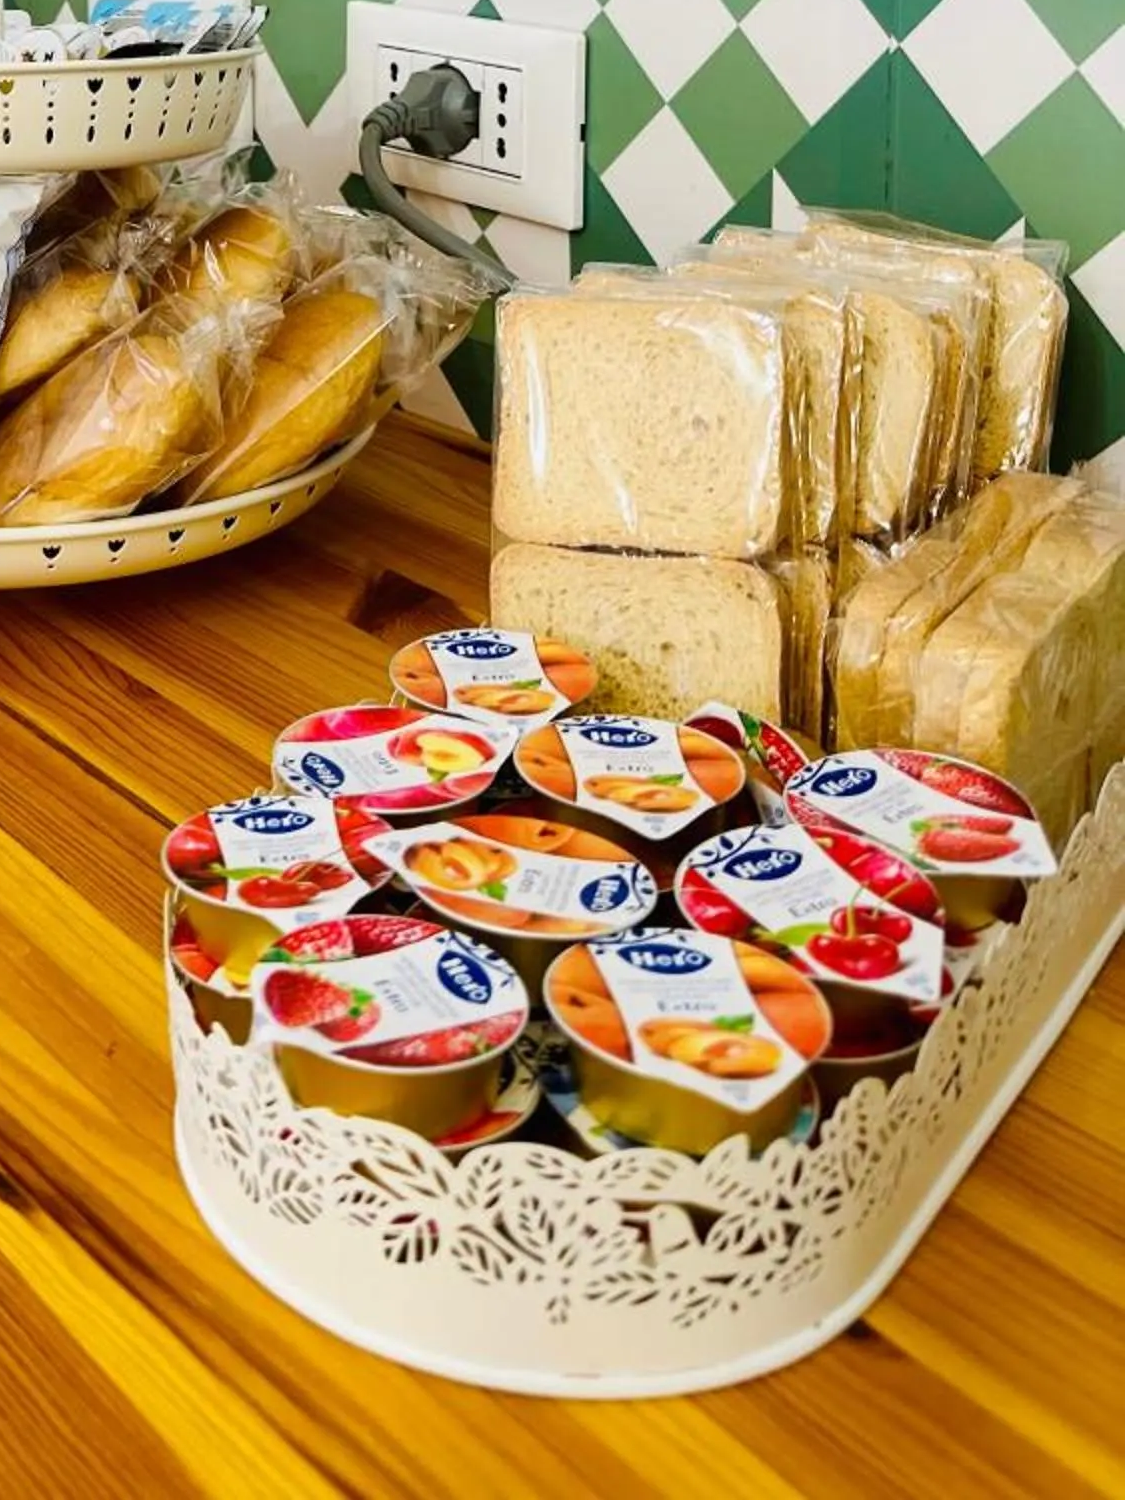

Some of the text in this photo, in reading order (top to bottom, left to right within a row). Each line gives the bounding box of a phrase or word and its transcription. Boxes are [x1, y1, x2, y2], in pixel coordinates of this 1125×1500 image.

[456, 643, 511, 656] Hero
[589, 731, 651, 744] Hero
[820, 769, 872, 796] Hero
[243, 813, 308, 830] Hero
[733, 851, 796, 879] Hero
[630, 950, 703, 967] Hero
[440, 957, 489, 1002] Hero
